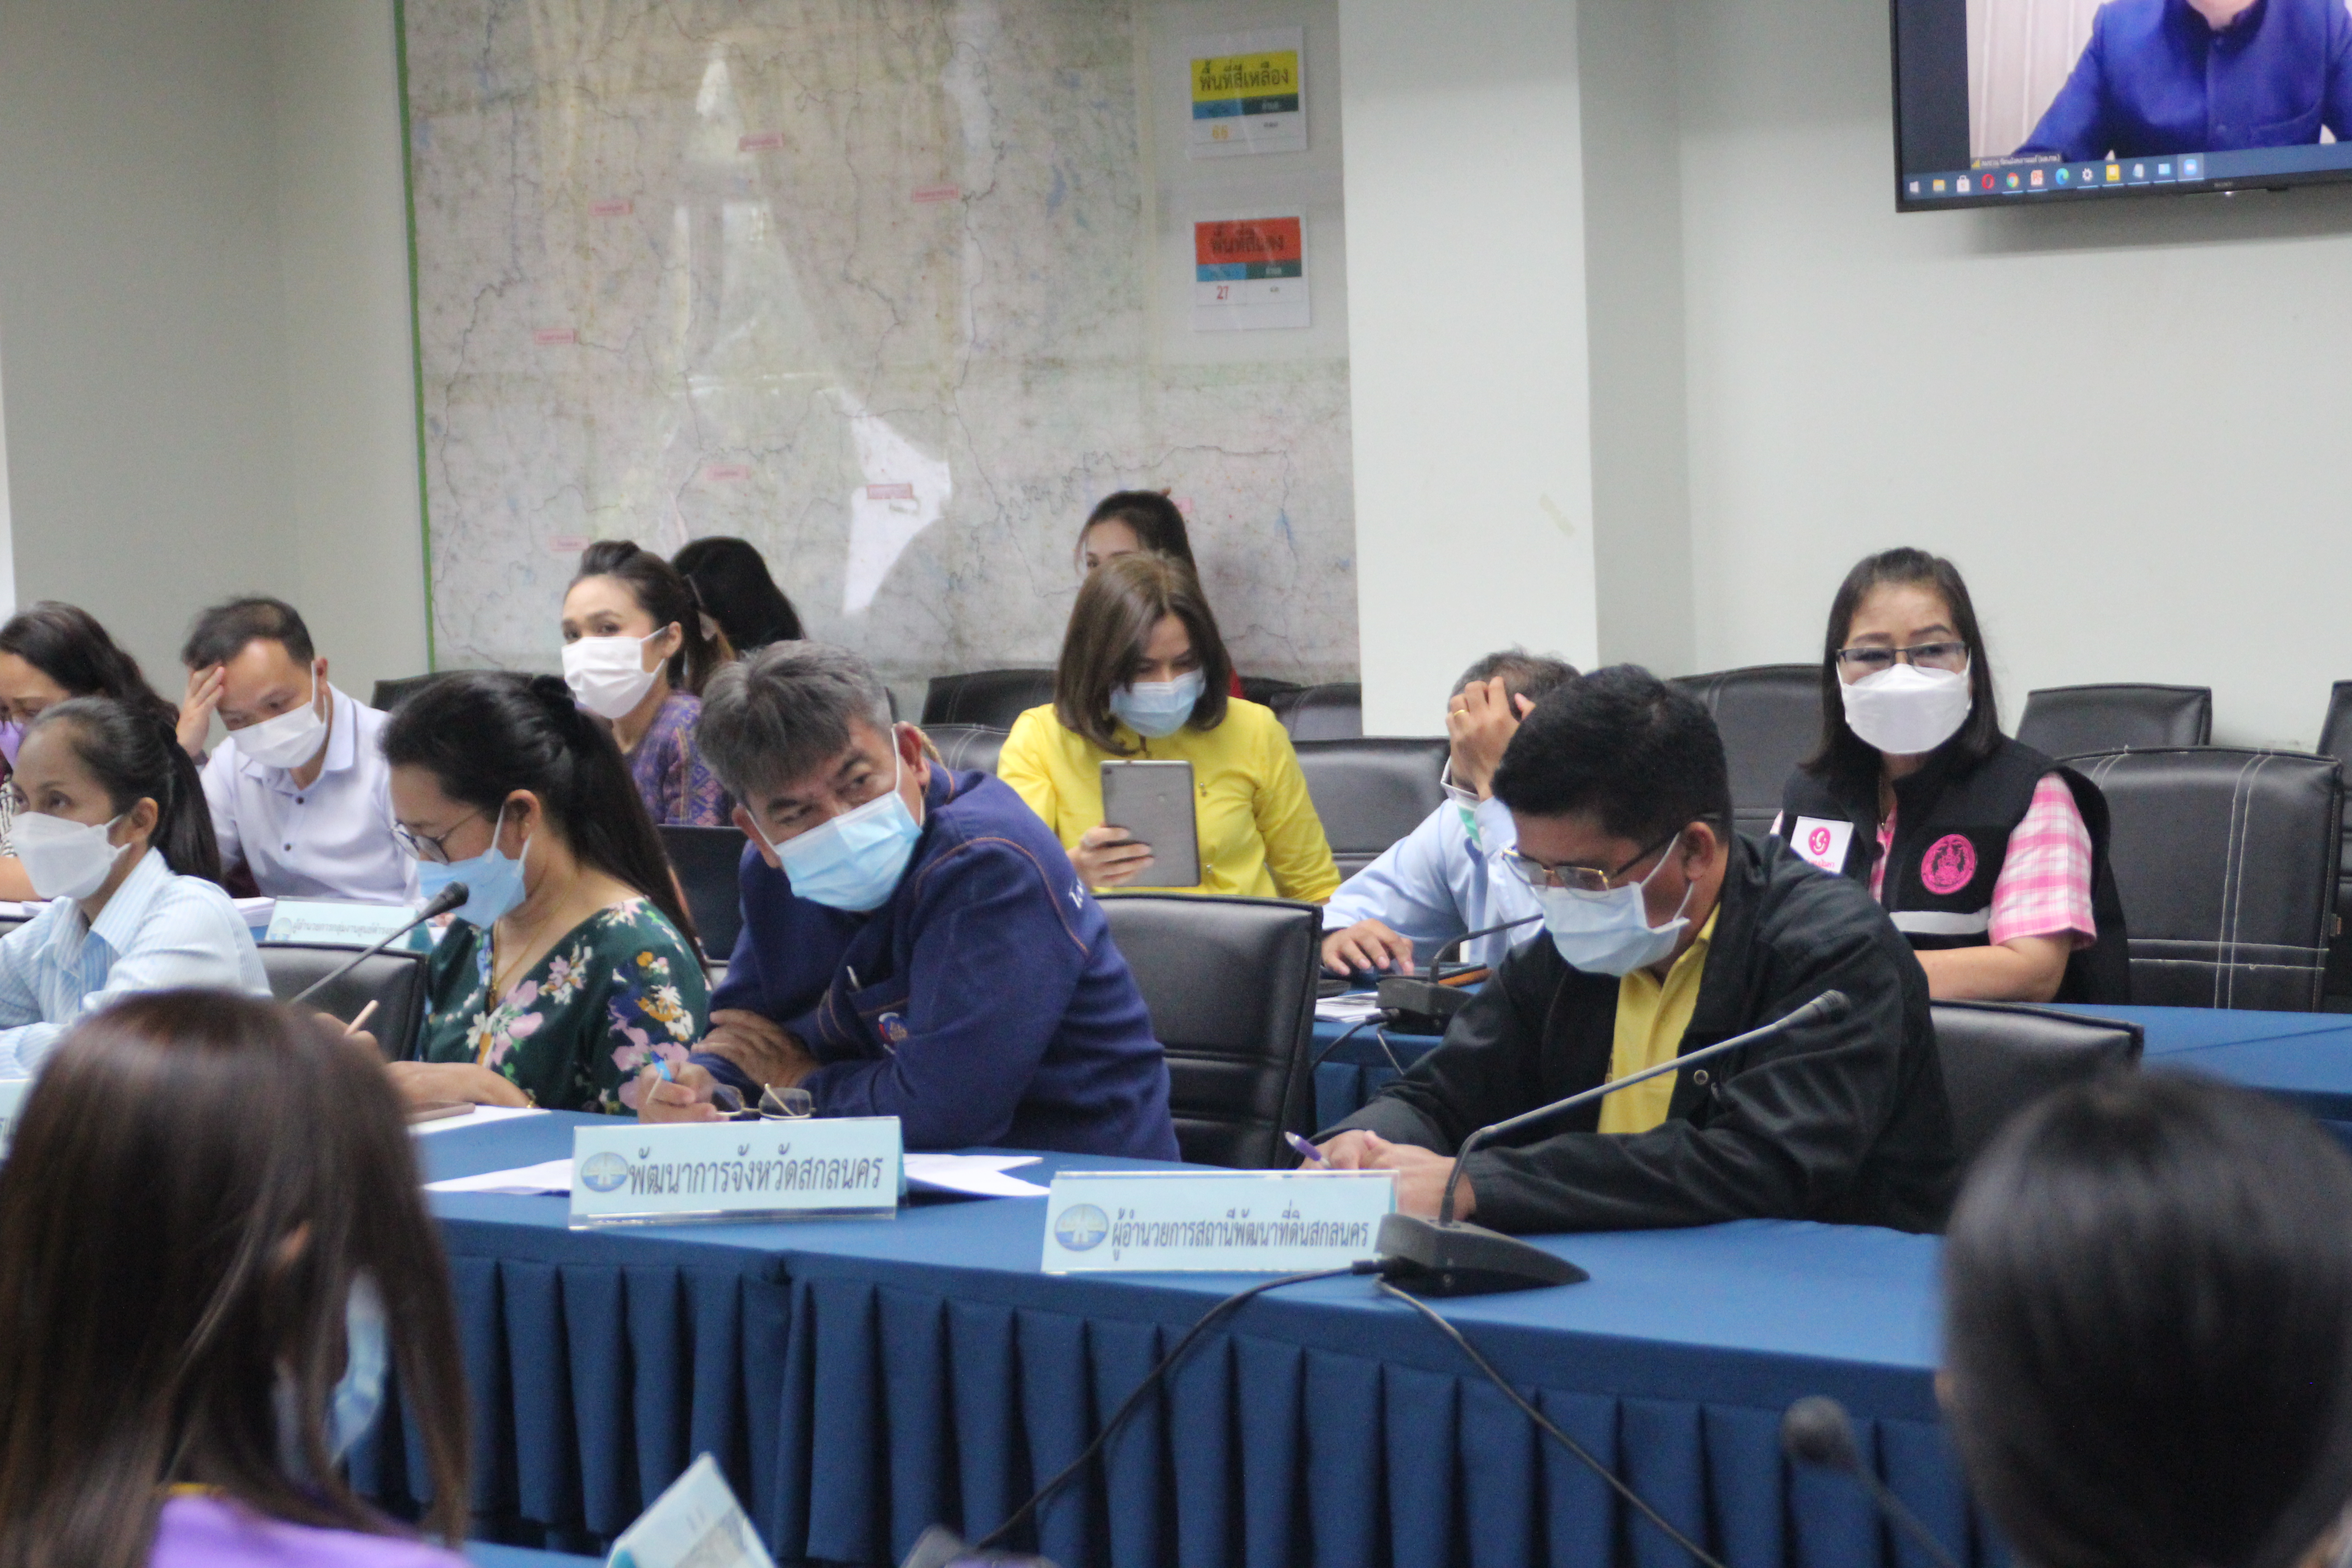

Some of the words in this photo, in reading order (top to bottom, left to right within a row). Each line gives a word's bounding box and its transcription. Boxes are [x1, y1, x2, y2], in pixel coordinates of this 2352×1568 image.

[1216, 285, 1229, 300] 27
[628, 1142, 883, 1195] พัฒนาการจังหวัดสกลนคร
[1111, 1199, 1369, 1261] ผู้อำนวยการสถานีพัฒนาที่ดินสกลนคร
